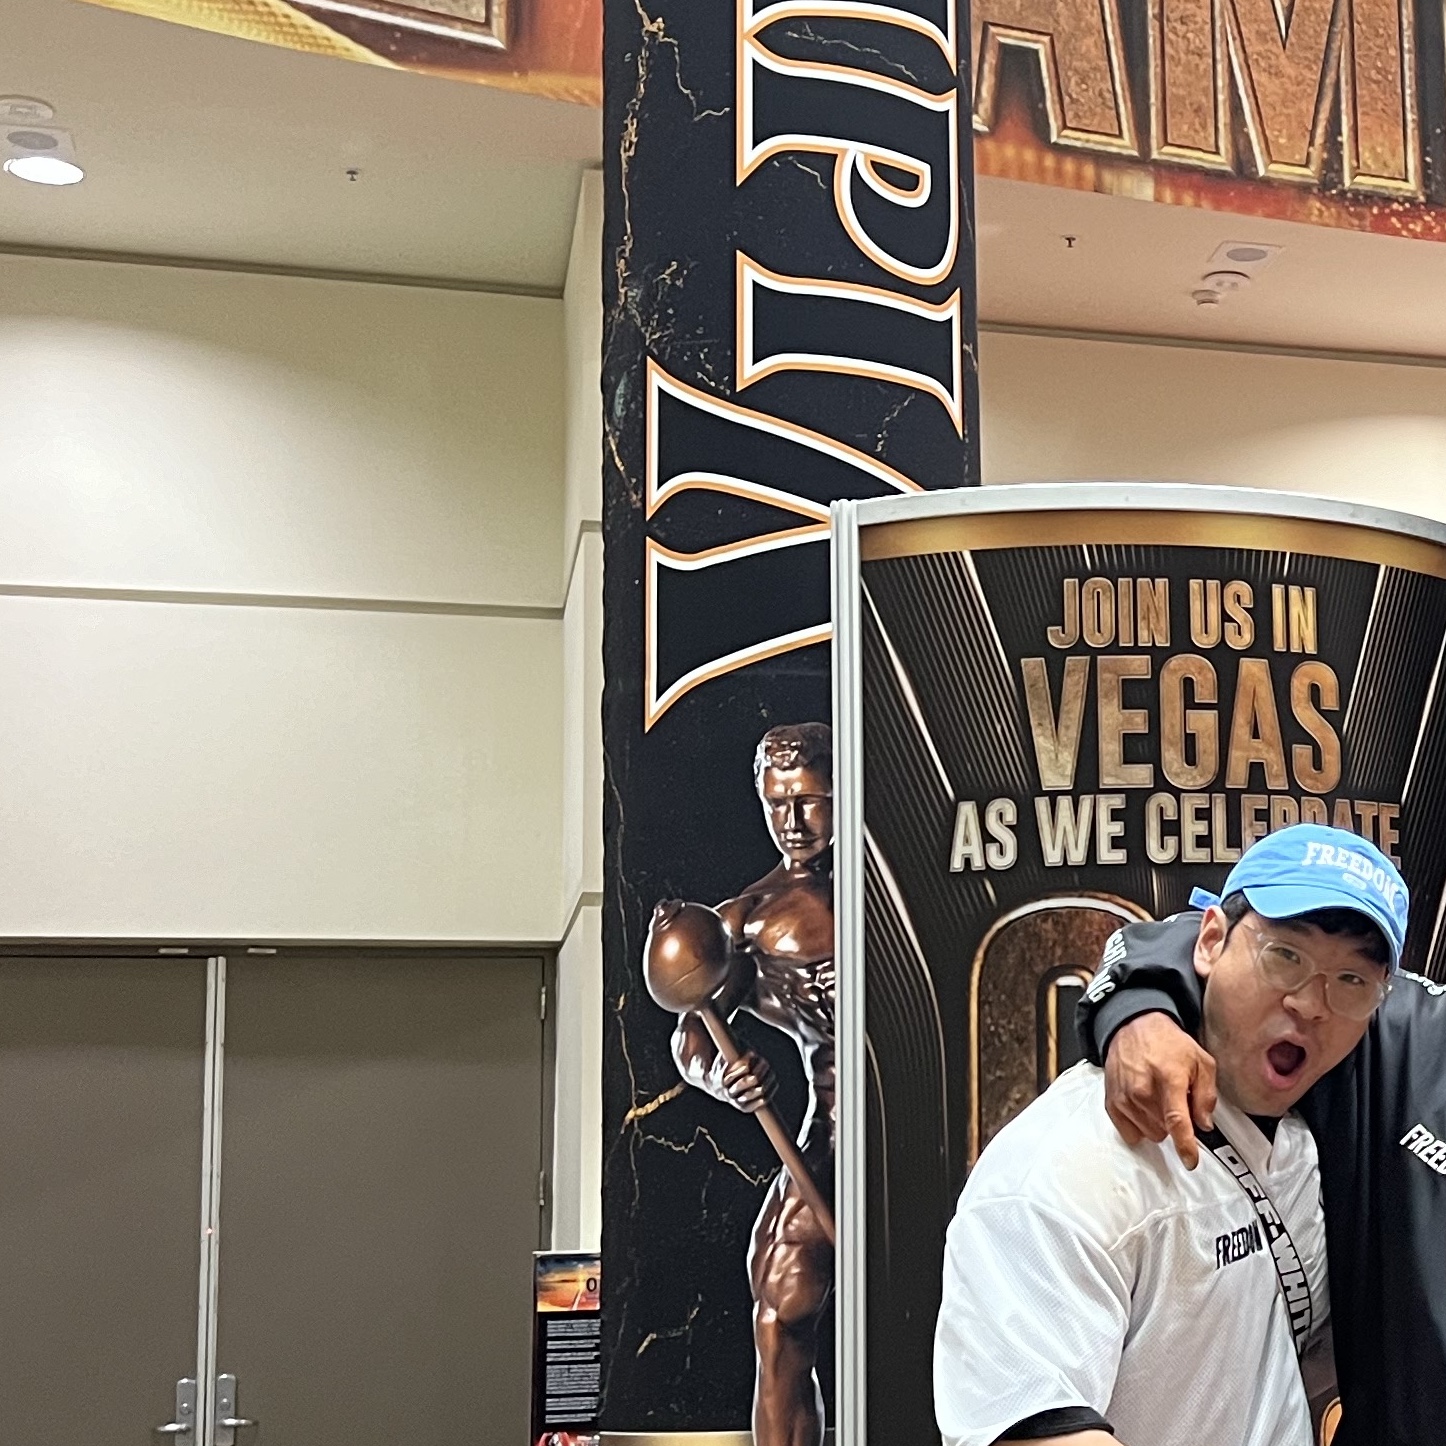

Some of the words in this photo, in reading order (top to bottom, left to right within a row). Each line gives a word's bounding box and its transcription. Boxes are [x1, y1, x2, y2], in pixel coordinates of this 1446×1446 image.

[1046, 577, 1171, 649] JOIN
[1189, 579, 1255, 651] US
[1271, 583, 1318, 655] IN
[1020, 653, 1341, 794] VEGAS
[949, 801, 1018, 872] AS
[1034, 794, 1127, 866] WE
